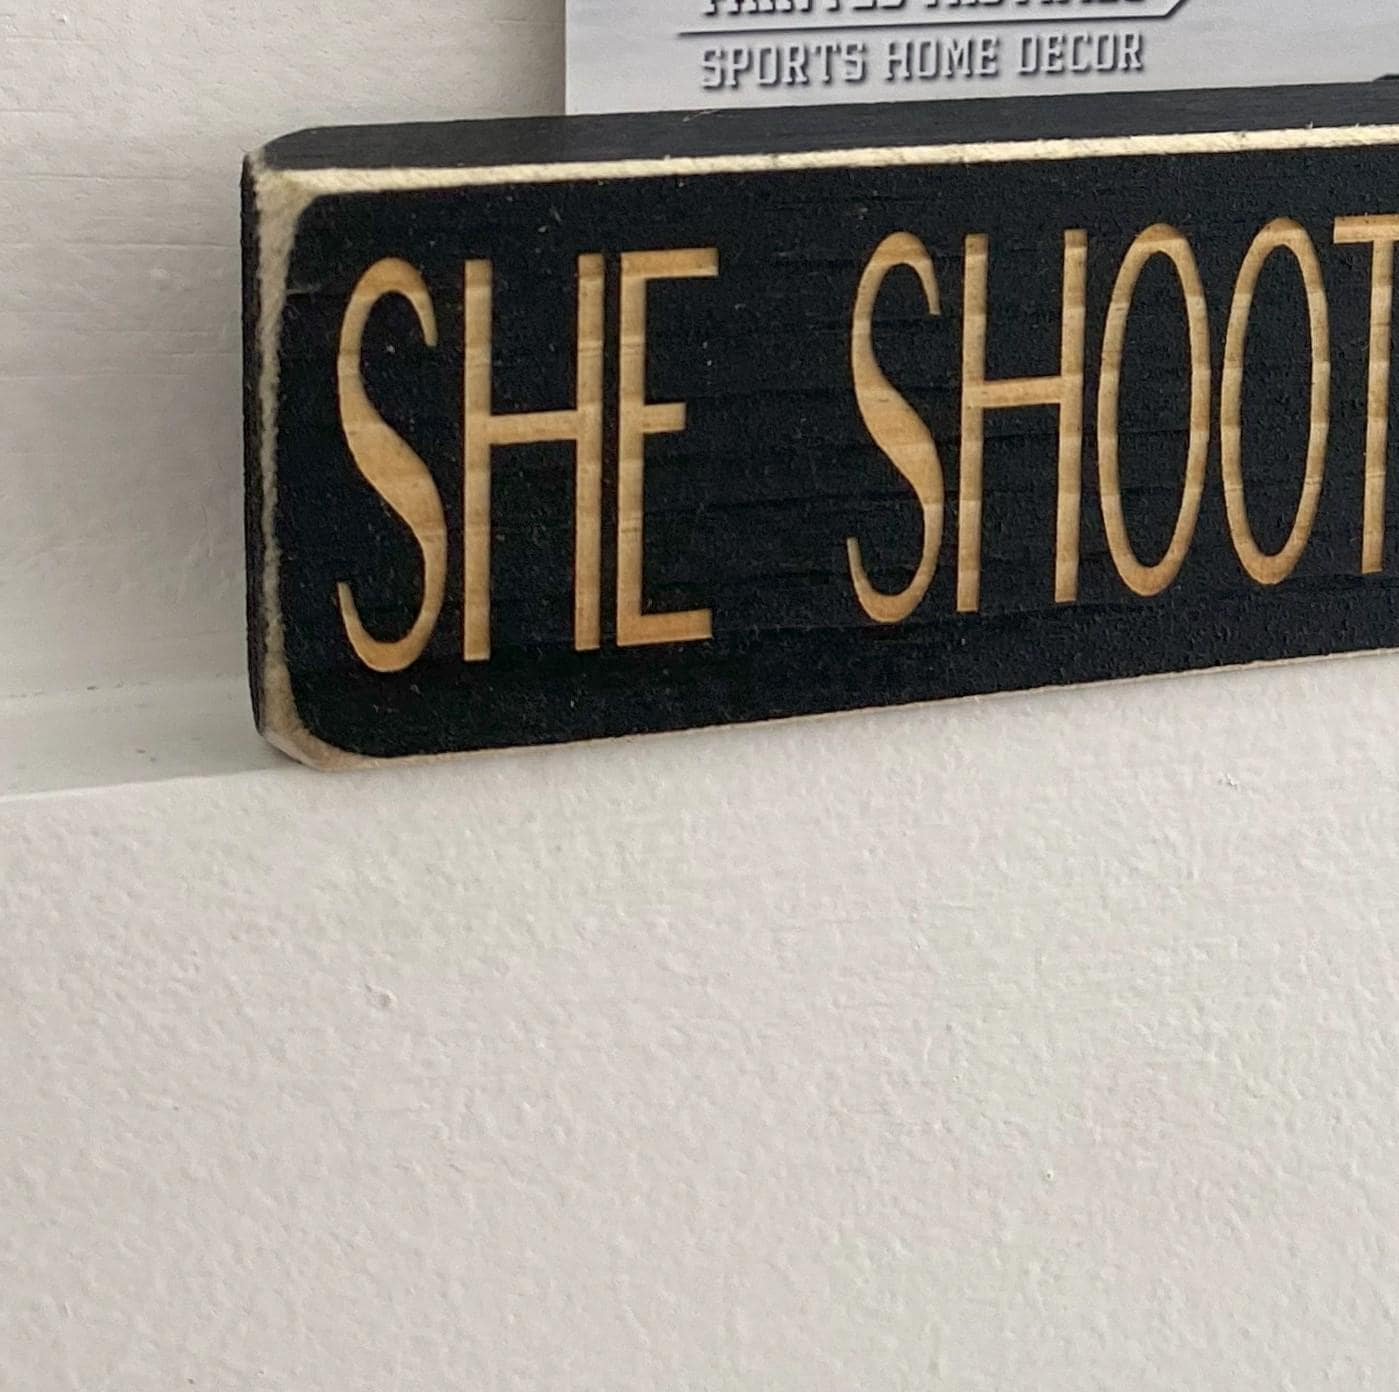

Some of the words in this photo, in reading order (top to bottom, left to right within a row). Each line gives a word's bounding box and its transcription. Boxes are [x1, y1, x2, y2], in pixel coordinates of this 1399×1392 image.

[701, 40, 867, 89] SPORTS
[884, 34, 1000, 82] HOME
[1016, 28, 1143, 76] DECOR
[336, 249, 717, 673] SHE
